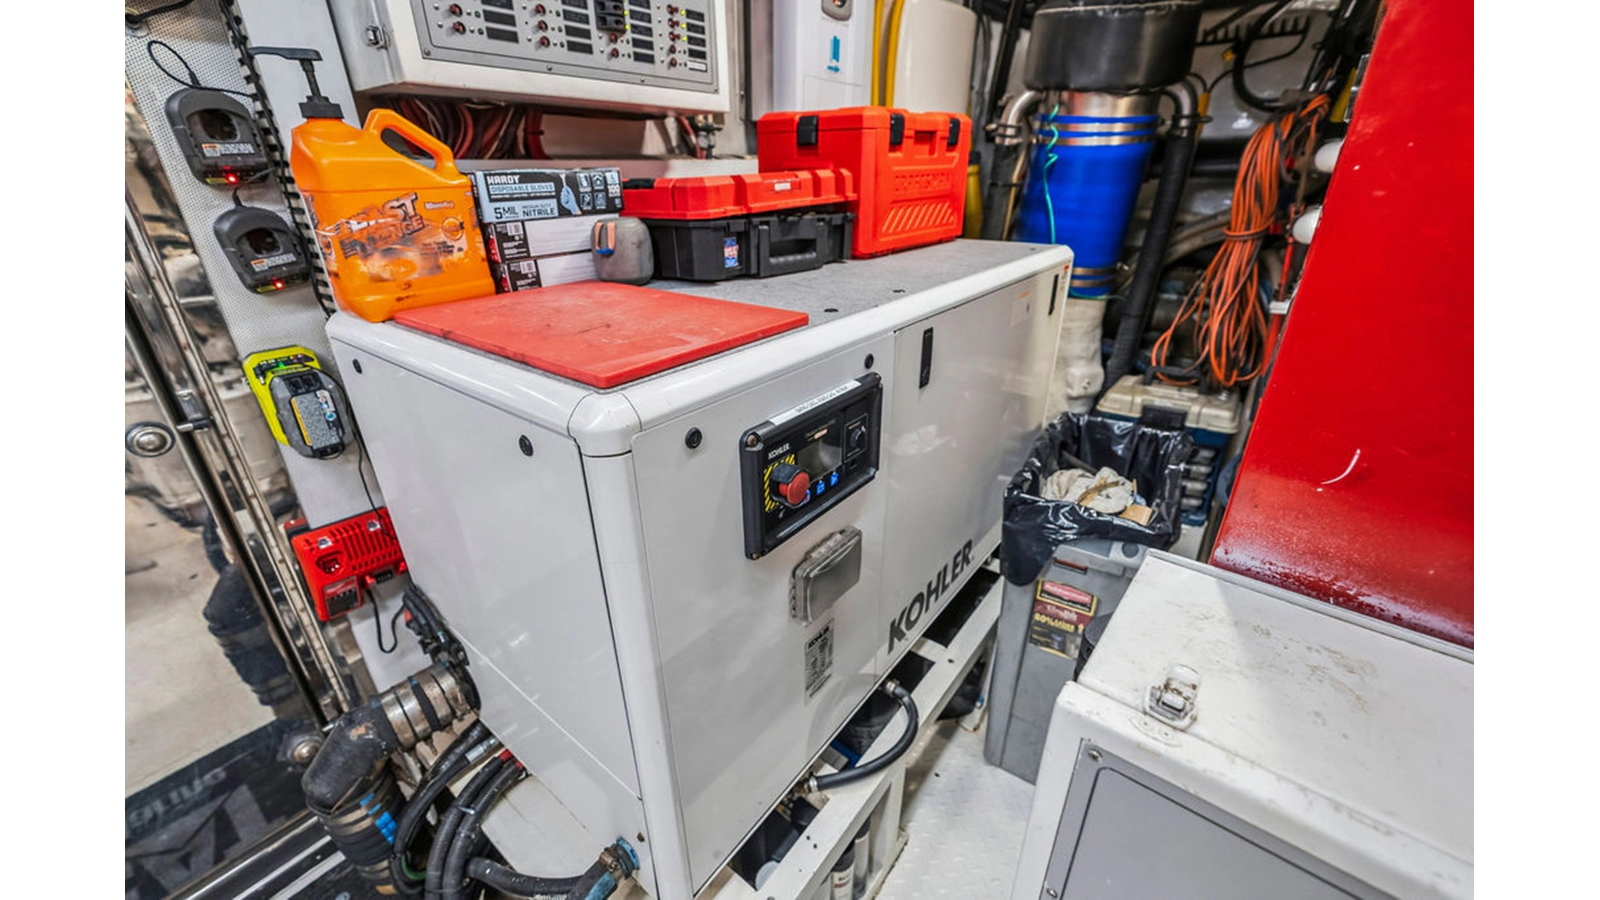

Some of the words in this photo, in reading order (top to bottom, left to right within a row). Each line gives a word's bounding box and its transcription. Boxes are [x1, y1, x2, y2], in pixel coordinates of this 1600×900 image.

[486, 174, 520, 185] HARDY
[494, 207, 503, 220] 5
[502, 206, 519, 216] MIL
[522, 208, 555, 218] NITRILE
[768, 443, 790, 460] KOHLER
[888, 539, 973, 655] KOHLER
